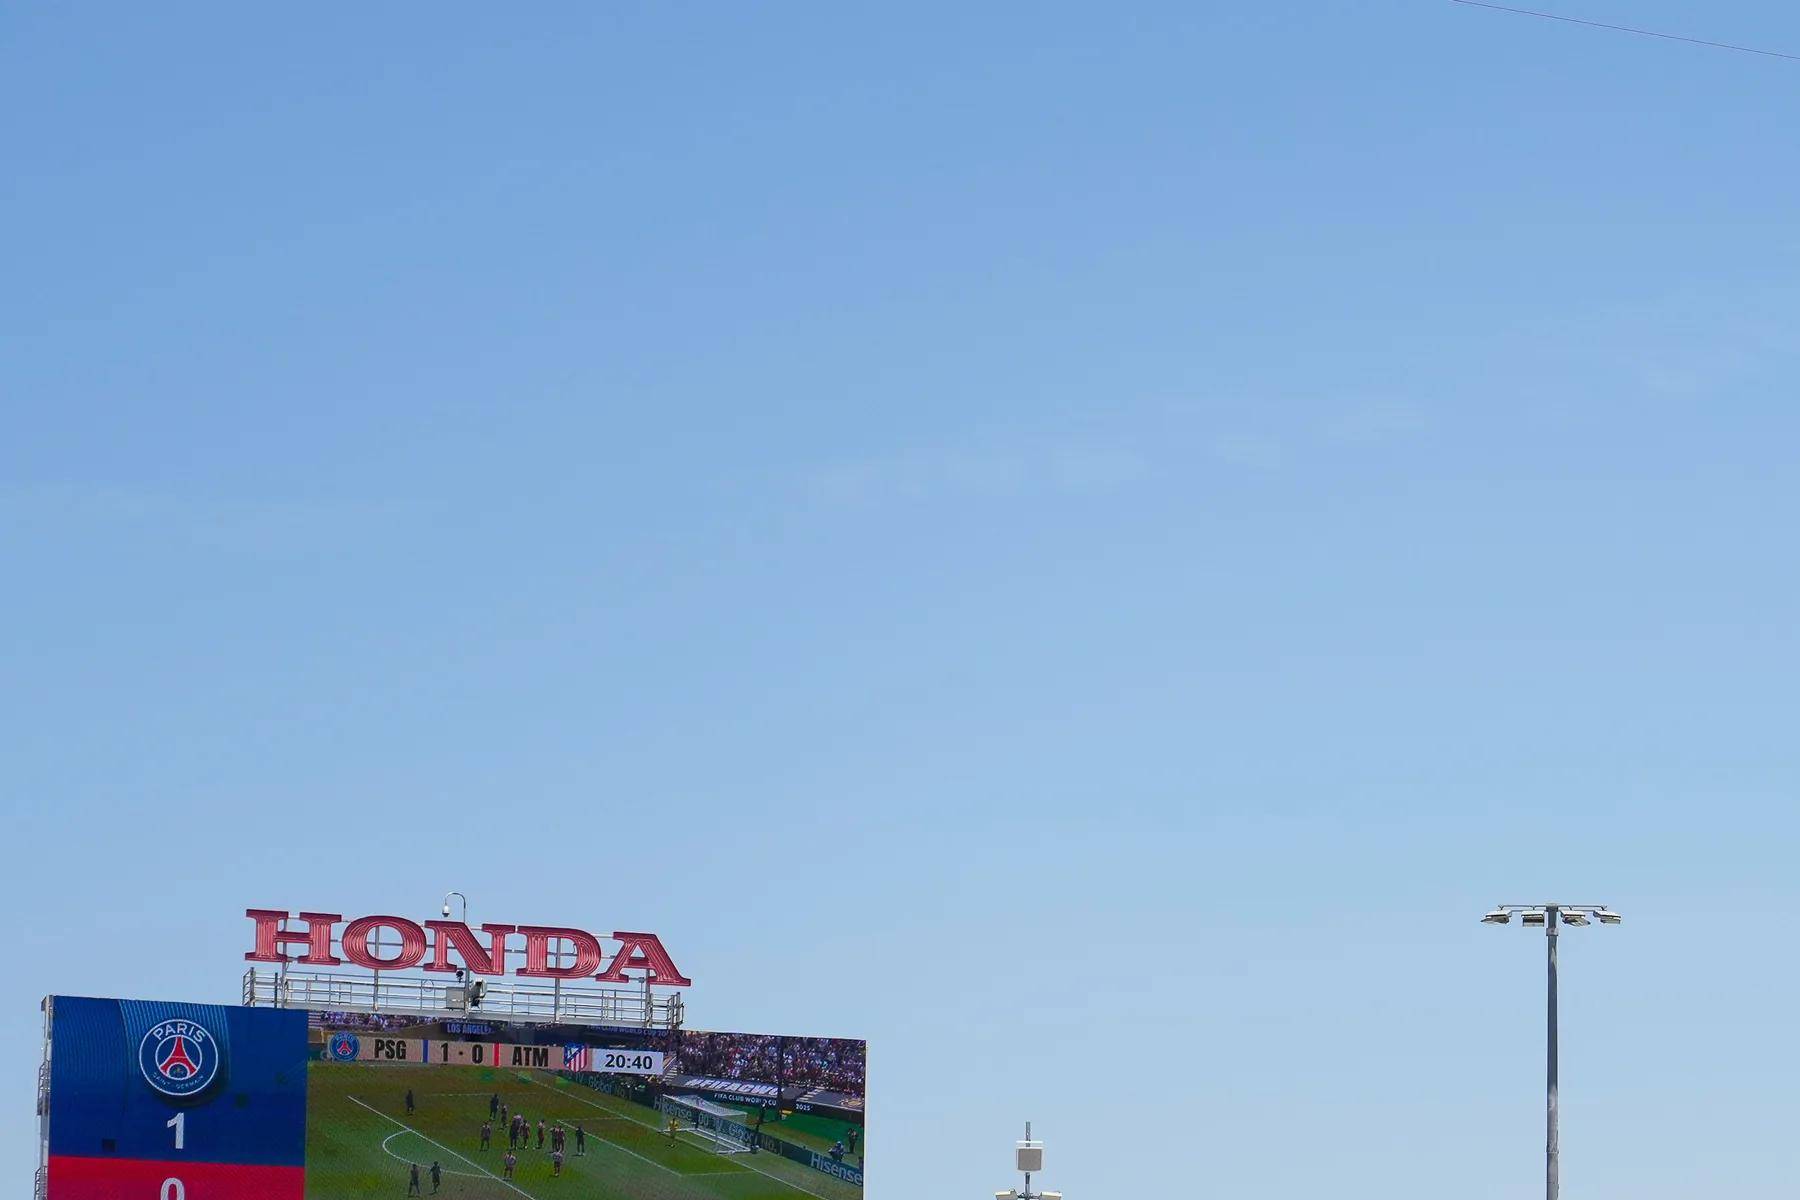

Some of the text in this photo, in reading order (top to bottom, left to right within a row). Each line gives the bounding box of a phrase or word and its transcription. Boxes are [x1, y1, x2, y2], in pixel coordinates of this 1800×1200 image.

[245, 909, 691, 986] HONDA
[153, 1023, 206, 1043] PARIS
[374, 1038, 653, 1069] PSG 1 0 ATM 20:40
[167, 1112, 184, 1149] 1
[809, 1152, 864, 1187] Hisense
